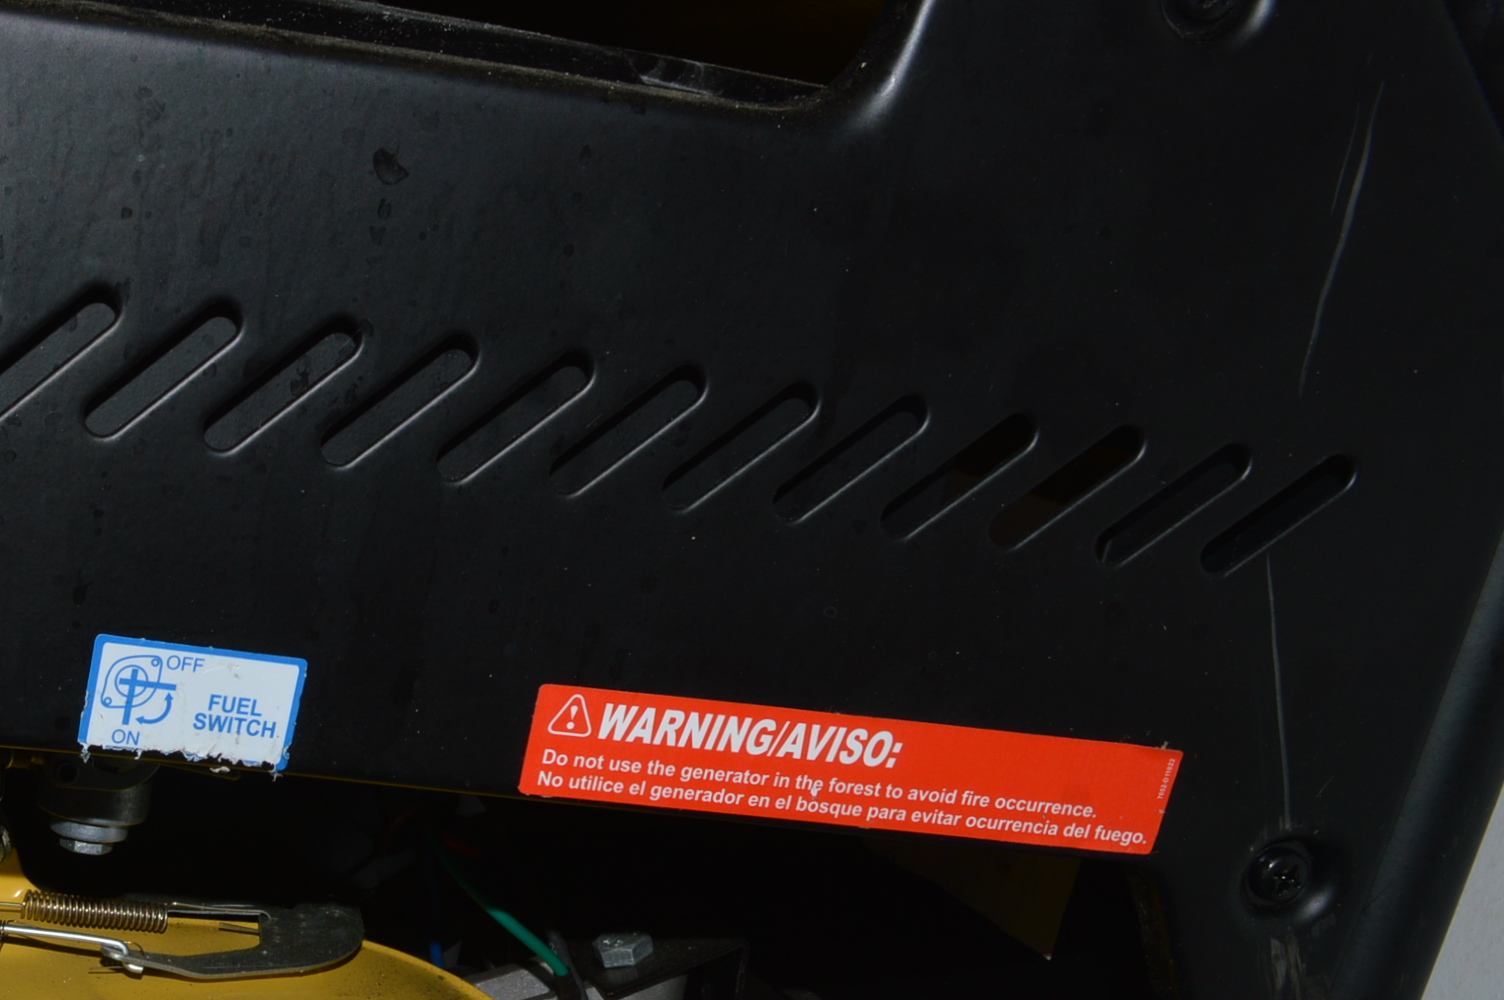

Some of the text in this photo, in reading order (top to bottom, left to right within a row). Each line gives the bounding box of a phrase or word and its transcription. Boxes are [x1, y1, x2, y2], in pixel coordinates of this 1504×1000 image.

[166, 655, 205, 672] OFF
[208, 694, 262, 717] FUEL
[111, 729, 140, 745] ON
[193, 712, 277, 738] SWITCH
[597, 703, 903, 768] WARNING/AVISO:
[542, 748, 1097, 818] Do not use the generator in the forest to avoid fire occurrence.
[537, 770, 1147, 847] No utilice el generador en el bosque para evitar ocurrencia del fuego.
